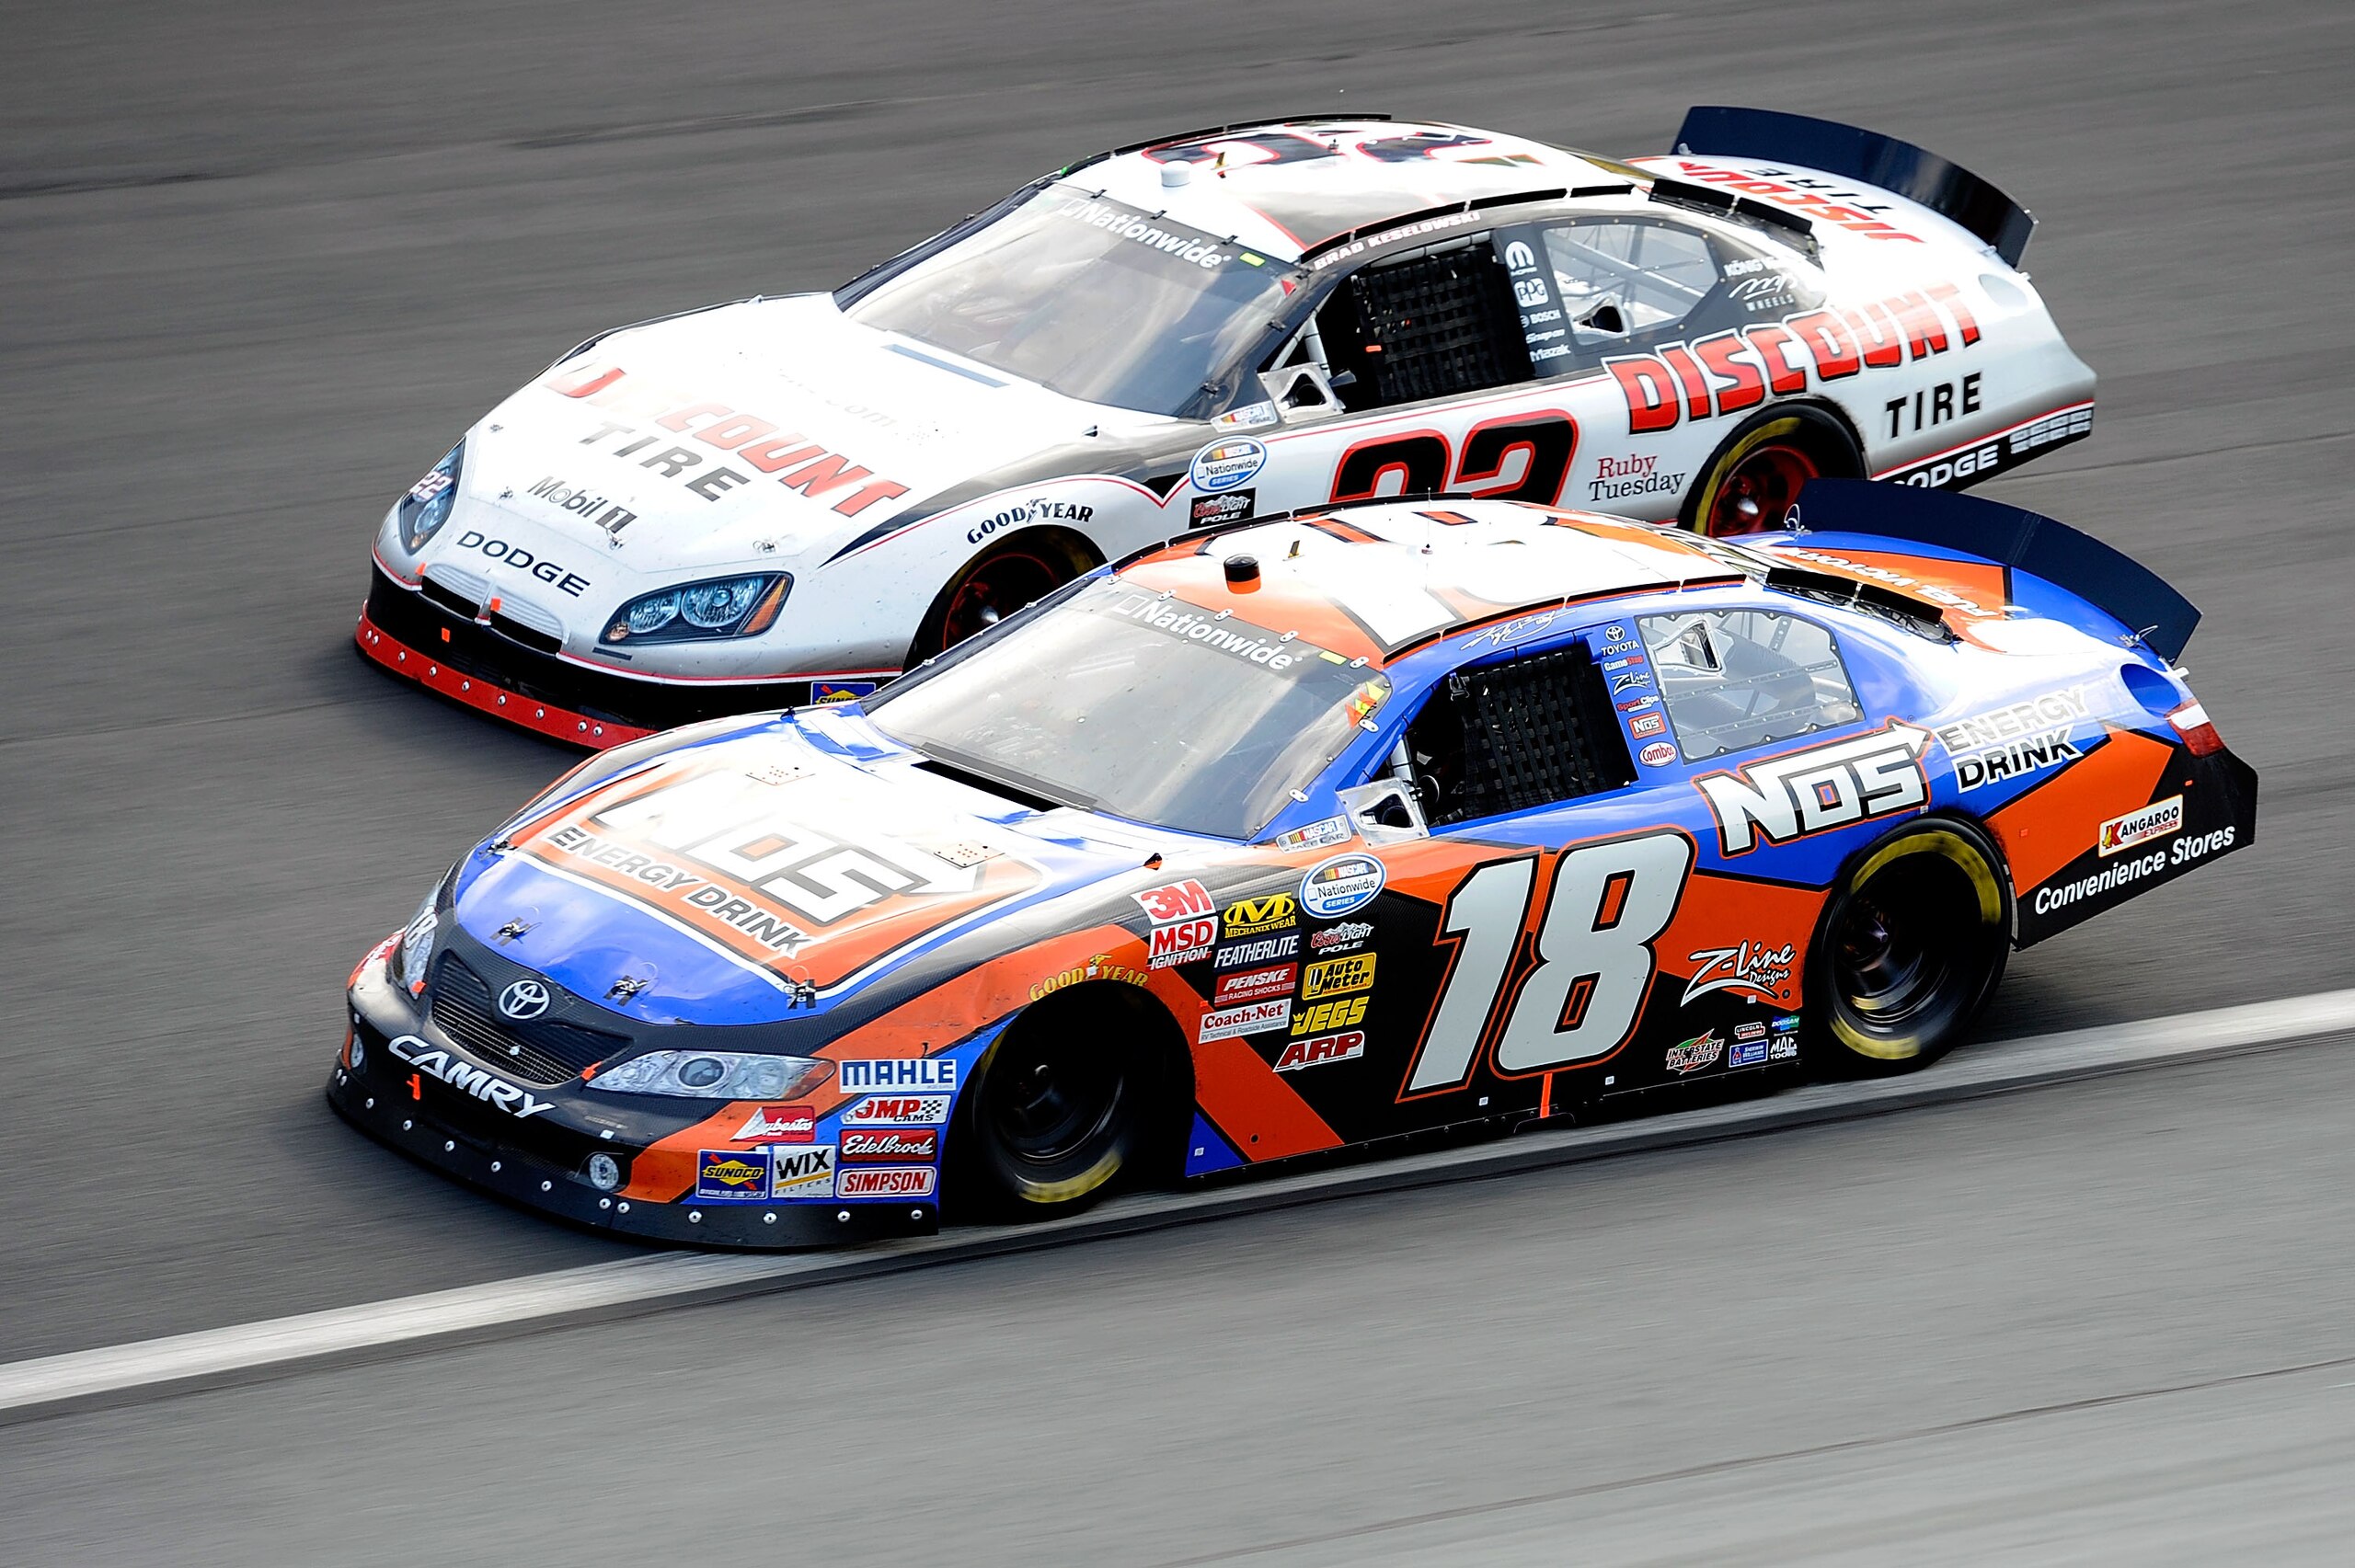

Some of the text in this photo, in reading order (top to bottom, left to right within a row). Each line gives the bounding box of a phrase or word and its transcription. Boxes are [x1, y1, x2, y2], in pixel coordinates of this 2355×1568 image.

[1074, 201, 1225, 269] Nationwide
[1314, 211, 1481, 271] BRAD KESELOWSKI
[1517, 280, 1546, 302] PPG
[1530, 309, 1562, 325] BOSCH
[1530, 344, 1571, 362] Mazak
[1605, 280, 1982, 435] DISCOUNT
[1886, 372, 1982, 439] TIRE
[542, 357, 911, 517] DCOUNT
[579, 420, 752, 503] TIRE
[1206, 459, 1258, 476] Nationwide
[1596, 454, 1658, 479] Ruby
[1893, 444, 1999, 488] ODGE
[408, 470, 454, 500] 22
[1212, 475, 1239, 486] SERIES
[1589, 471, 1686, 502] Tuesday
[527, 476, 603, 519] Mobil
[1194, 498, 1251, 519] Coors LIGHT
[1200, 511, 1242, 525] POLE
[456, 530, 592, 598] DODGE
[1914, 584, 1999, 618] FUEL
[1132, 600, 1294, 670] Nationwide
[1601, 640, 1640, 658] TOYOTA
[1604, 654, 1644, 671] GameStop
[1611, 670, 1650, 696] Z-Line
[1633, 715, 1660, 735] NOS
[1936, 688, 2087, 752] ENERGY
[1641, 741, 1675, 763] Combos
[1956, 728, 2078, 789] DRINK
[1697, 722, 1933, 855] NOS
[1304, 821, 1338, 841] NASCAR
[1319, 832, 1345, 843] CAR
[2106, 807, 2179, 850] KANGAROO
[2144, 818, 2179, 838] EXPRESS
[1338, 863, 1370, 878] NASCAR
[2036, 826, 2235, 914] Convenience Stores
[550, 826, 812, 956] ENERGY DRINK
[1142, 880, 1212, 920] 3M
[1318, 878, 1376, 898] Nationwide
[1327, 897, 1356, 908] SERIES
[1154, 921, 1213, 956] MSD
[1224, 915, 1297, 939] MECHANIX WEAR
[1311, 925, 1374, 949] Coors LIGHT
[1150, 946, 1209, 971] IGNITION
[1214, 934, 1300, 968] FEATHERLITE
[1318, 940, 1363, 956] POLE
[1325, 959, 1364, 978] Auto
[1407, 832, 1691, 1091] 18
[1223, 968, 1291, 992] PENSKE
[1321, 971, 1370, 990] Meter
[1680, 941, 1797, 1007] Z-Line
[1749, 968, 1790, 986] Designs
[1228, 984, 1281, 1001] RACING SHOCKS
[1204, 1002, 1284, 1030] Coach-Net
[1291, 996, 1370, 1036] JEGS
[1210, 1030, 1232, 1039] Technical
[1238, 1024, 1260, 1035] Roadside
[1261, 1020, 1287, 1030] Assistance
[1736, 1024, 1761, 1034] LINCOLN
[1276, 1032, 1363, 1068] ARP
[1668, 1041, 1723, 1059] INTERSTATE
[1770, 1036, 1798, 1054] MAC
[1669, 1050, 1718, 1068] BATTERIES
[388, 1035, 556, 1119] CAMRY
[842, 1060, 954, 1086] MAHLE
[855, 1099, 921, 1119] OMP
[893, 1114, 934, 1123] CAMS
[842, 1134, 935, 1156] Edelbrock
[706, 1166, 762, 1179] SUNOCO
[775, 1148, 833, 1180] WIX
[775, 1178, 832, 1196] FILTERS
[844, 1171, 927, 1194] SIMPSON
